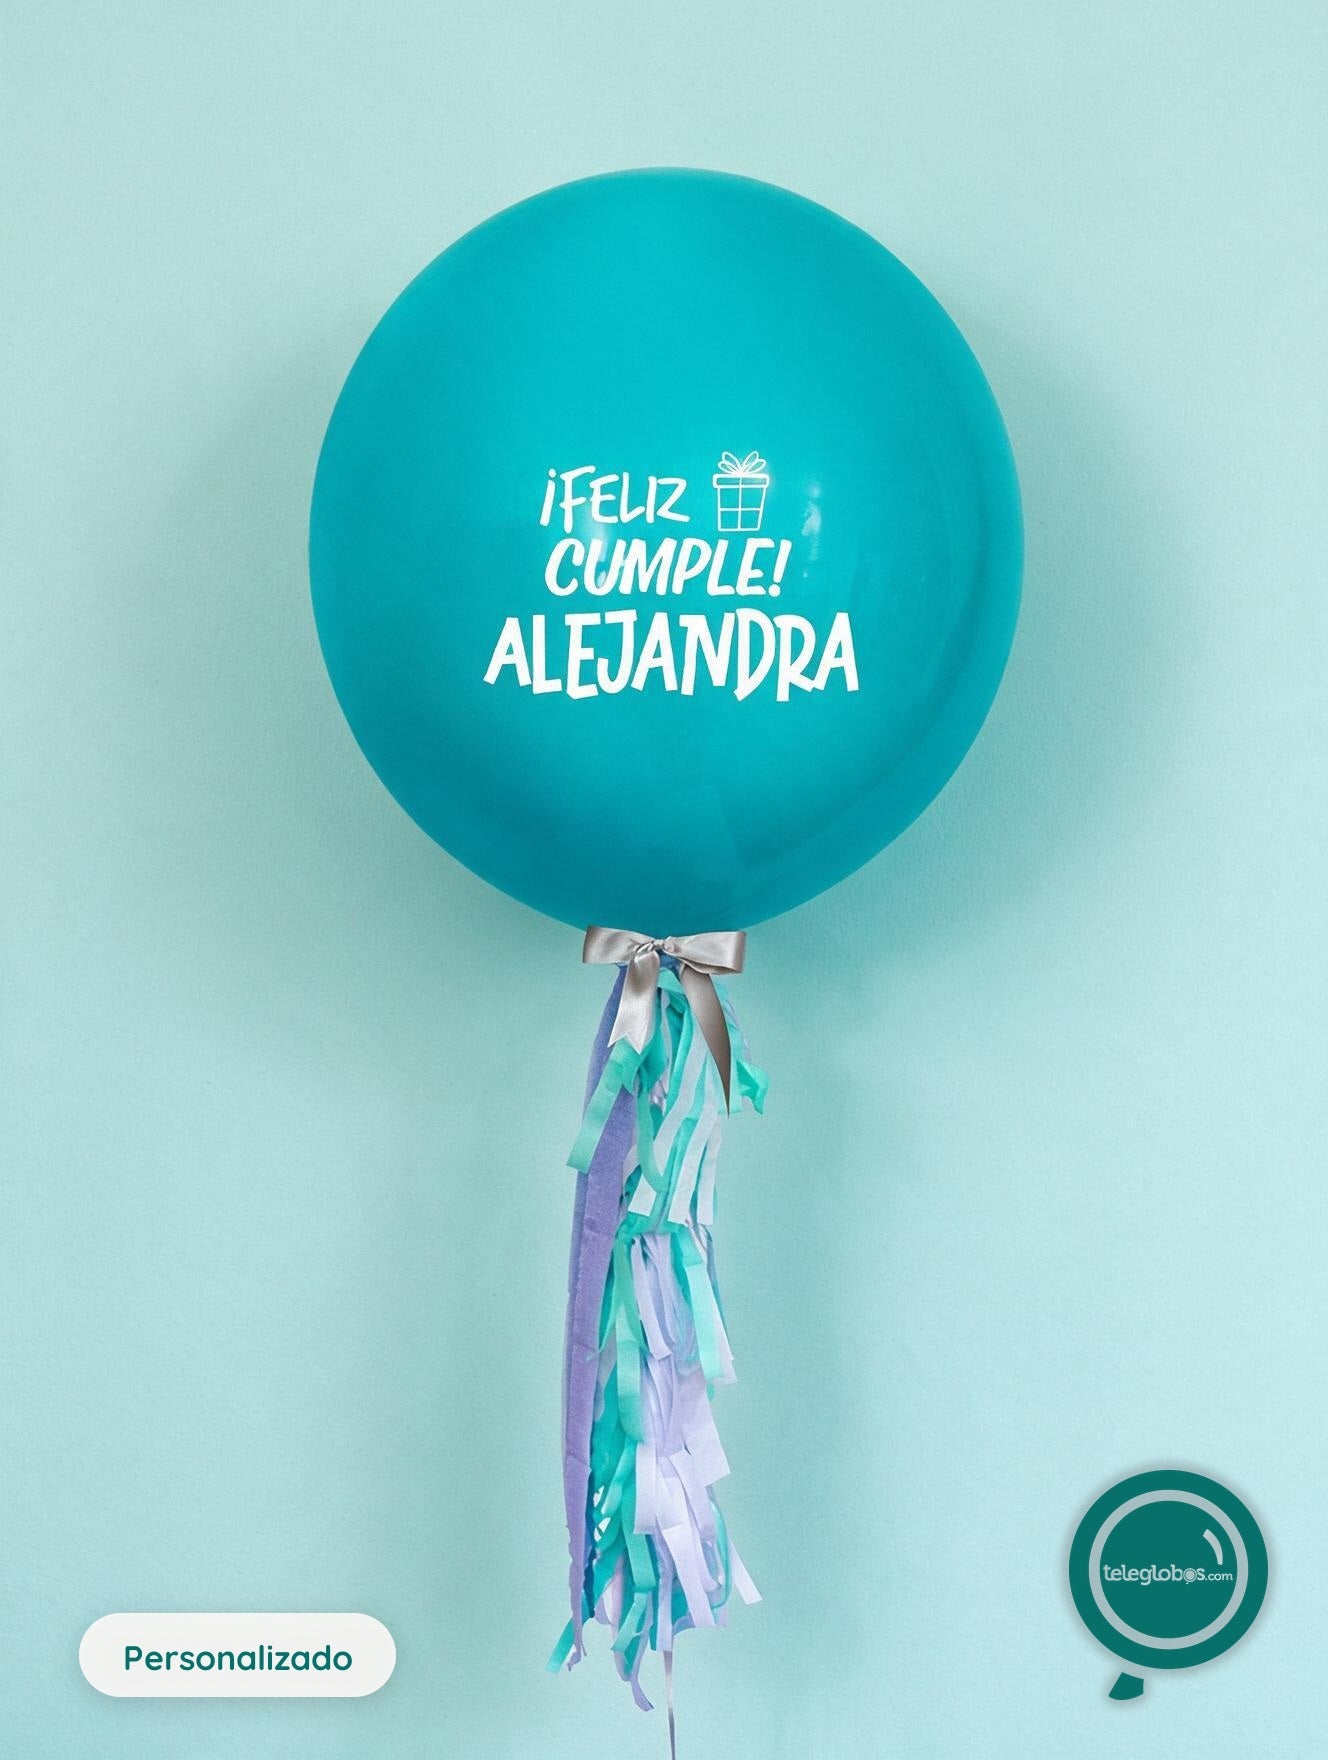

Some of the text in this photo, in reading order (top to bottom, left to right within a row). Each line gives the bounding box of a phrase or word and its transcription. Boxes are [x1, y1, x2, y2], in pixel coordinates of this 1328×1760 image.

[540, 465, 690, 534] ¡FELIZ
[544, 537, 792, 598] CUMPLE!
[483, 607, 859, 702] ALEJANDRA
